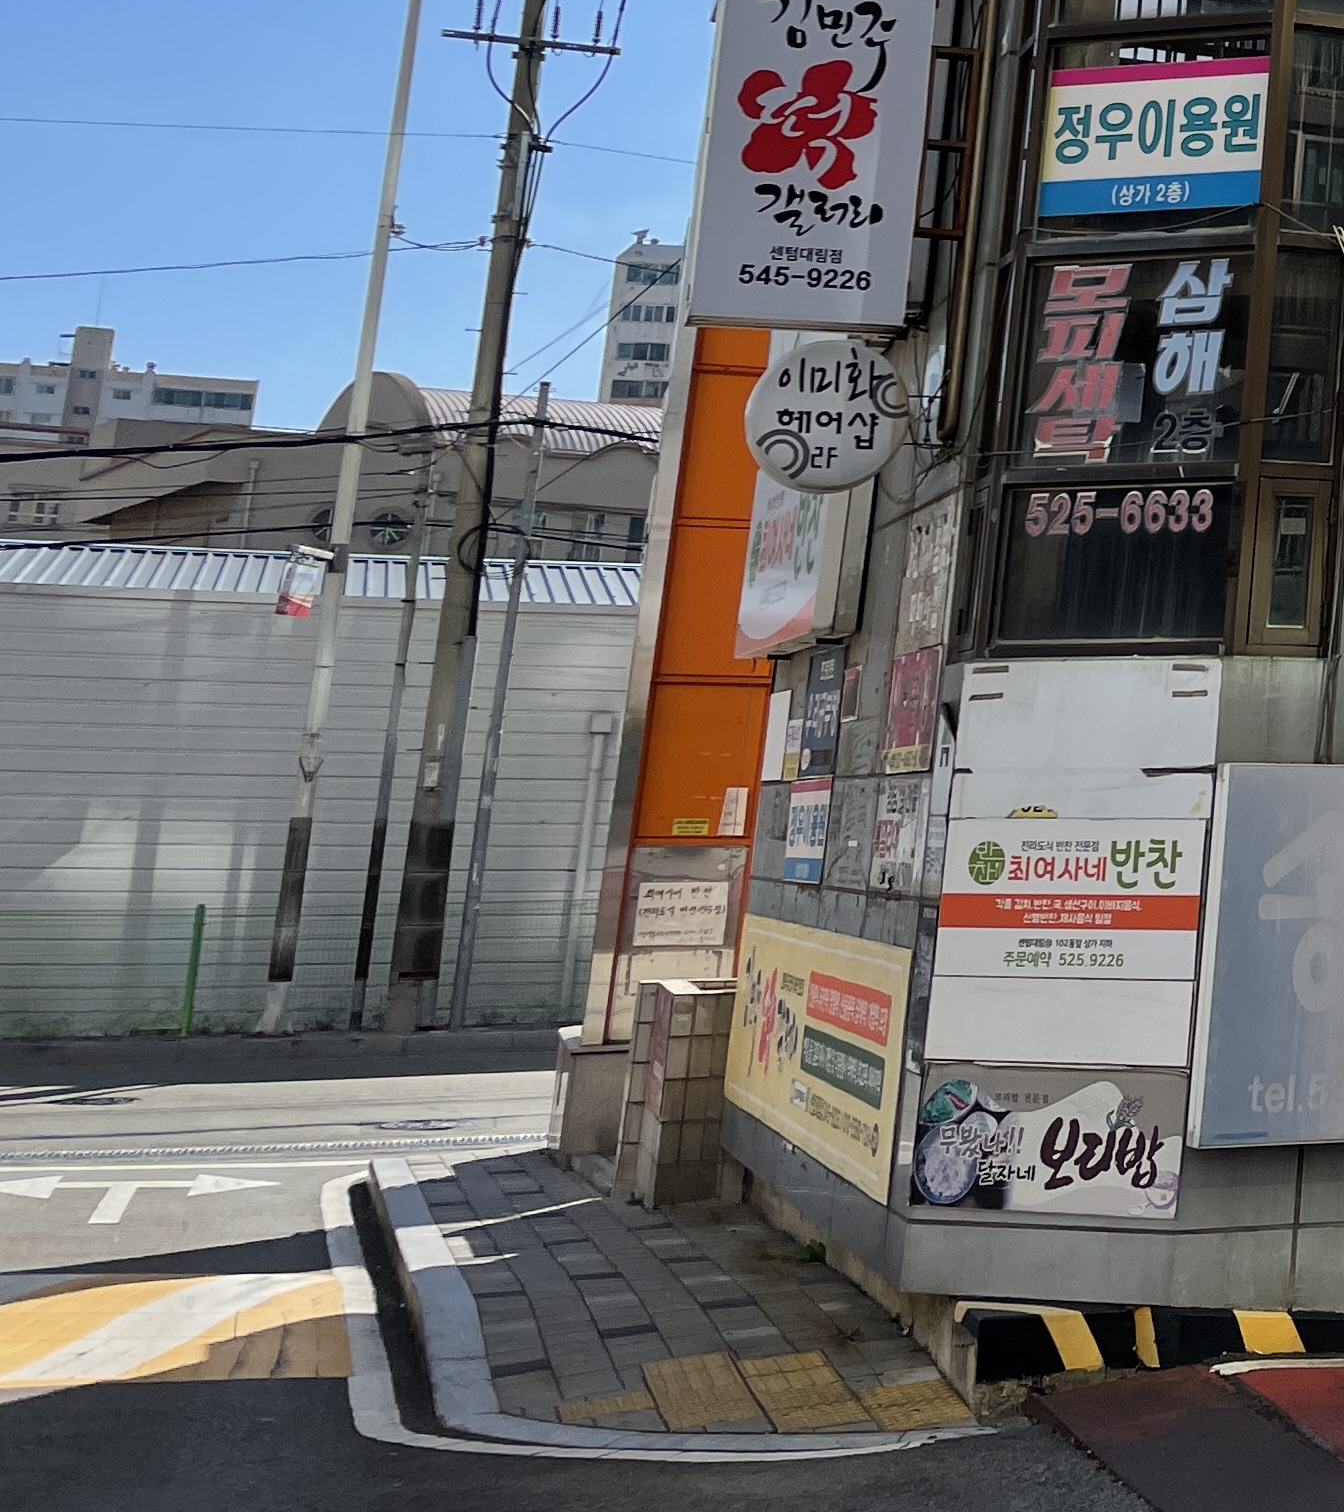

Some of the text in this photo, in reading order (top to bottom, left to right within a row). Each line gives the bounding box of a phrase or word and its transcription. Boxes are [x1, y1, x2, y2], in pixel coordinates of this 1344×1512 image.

[1053, 93, 1262, 166] 정우이용원
[754, 182, 883, 238] 갤러리
[1110, 180, 1190, 207] (상가 2층)
[738, 264, 872, 291] 545-9226
[769, 245, 843, 265] 센텀대림점
[1153, 258, 1234, 396] 삼해
[778, 347, 893, 403] 이미화
[776, 408, 880, 451] 헤어샵
[1024, 489, 1214, 537] 525-6633
[1007, 838, 1183, 890] 최여사네 반찬
[1058, 952, 1125, 968] 525.9226
[977, 1159, 1036, 1188] 달자네
[1039, 1116, 1166, 1191] 보리밥
